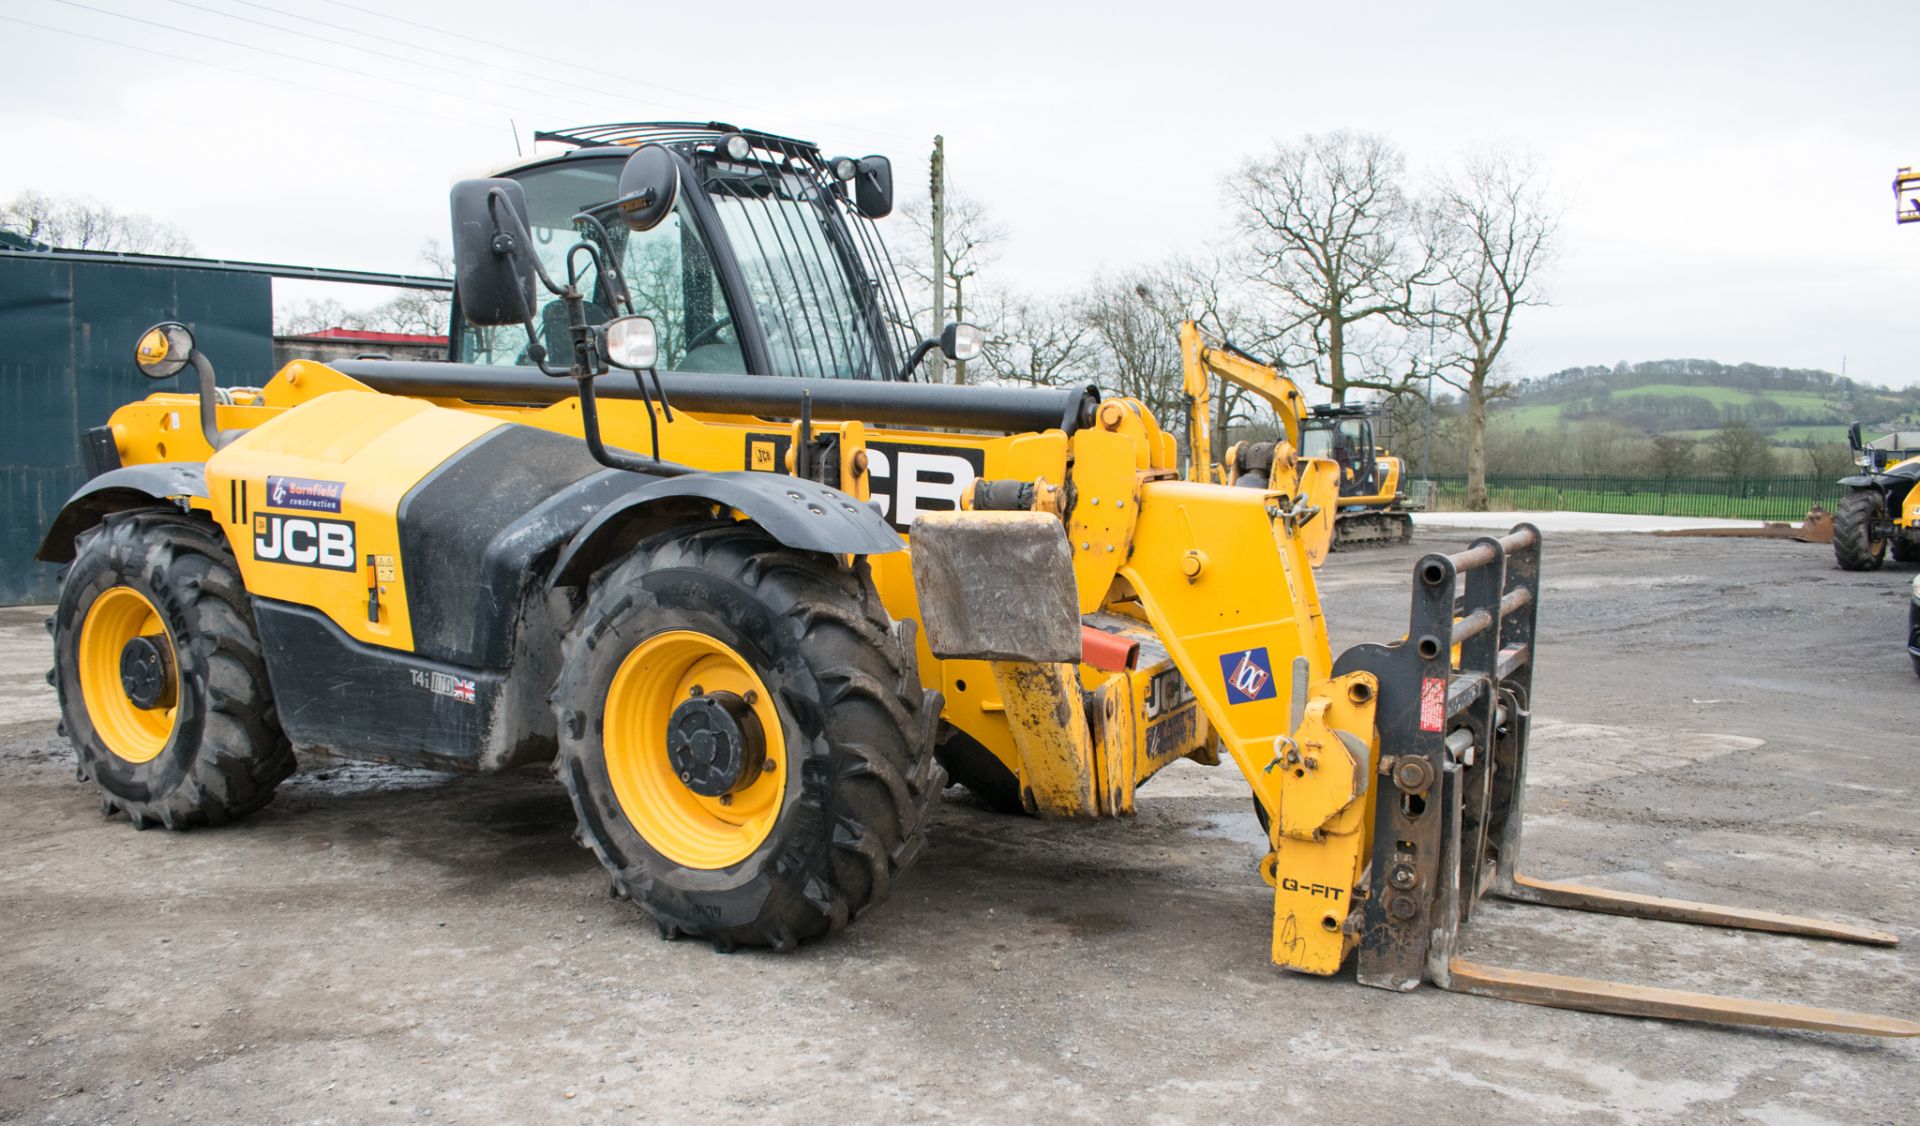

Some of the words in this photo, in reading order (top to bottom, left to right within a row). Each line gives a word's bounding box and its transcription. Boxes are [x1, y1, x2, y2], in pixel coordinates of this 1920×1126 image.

[289, 498, 336, 509] construction
[255, 517, 355, 568] JCB
[409, 668, 430, 688] T4i
[1282, 877, 1344, 900] Q-FIT
